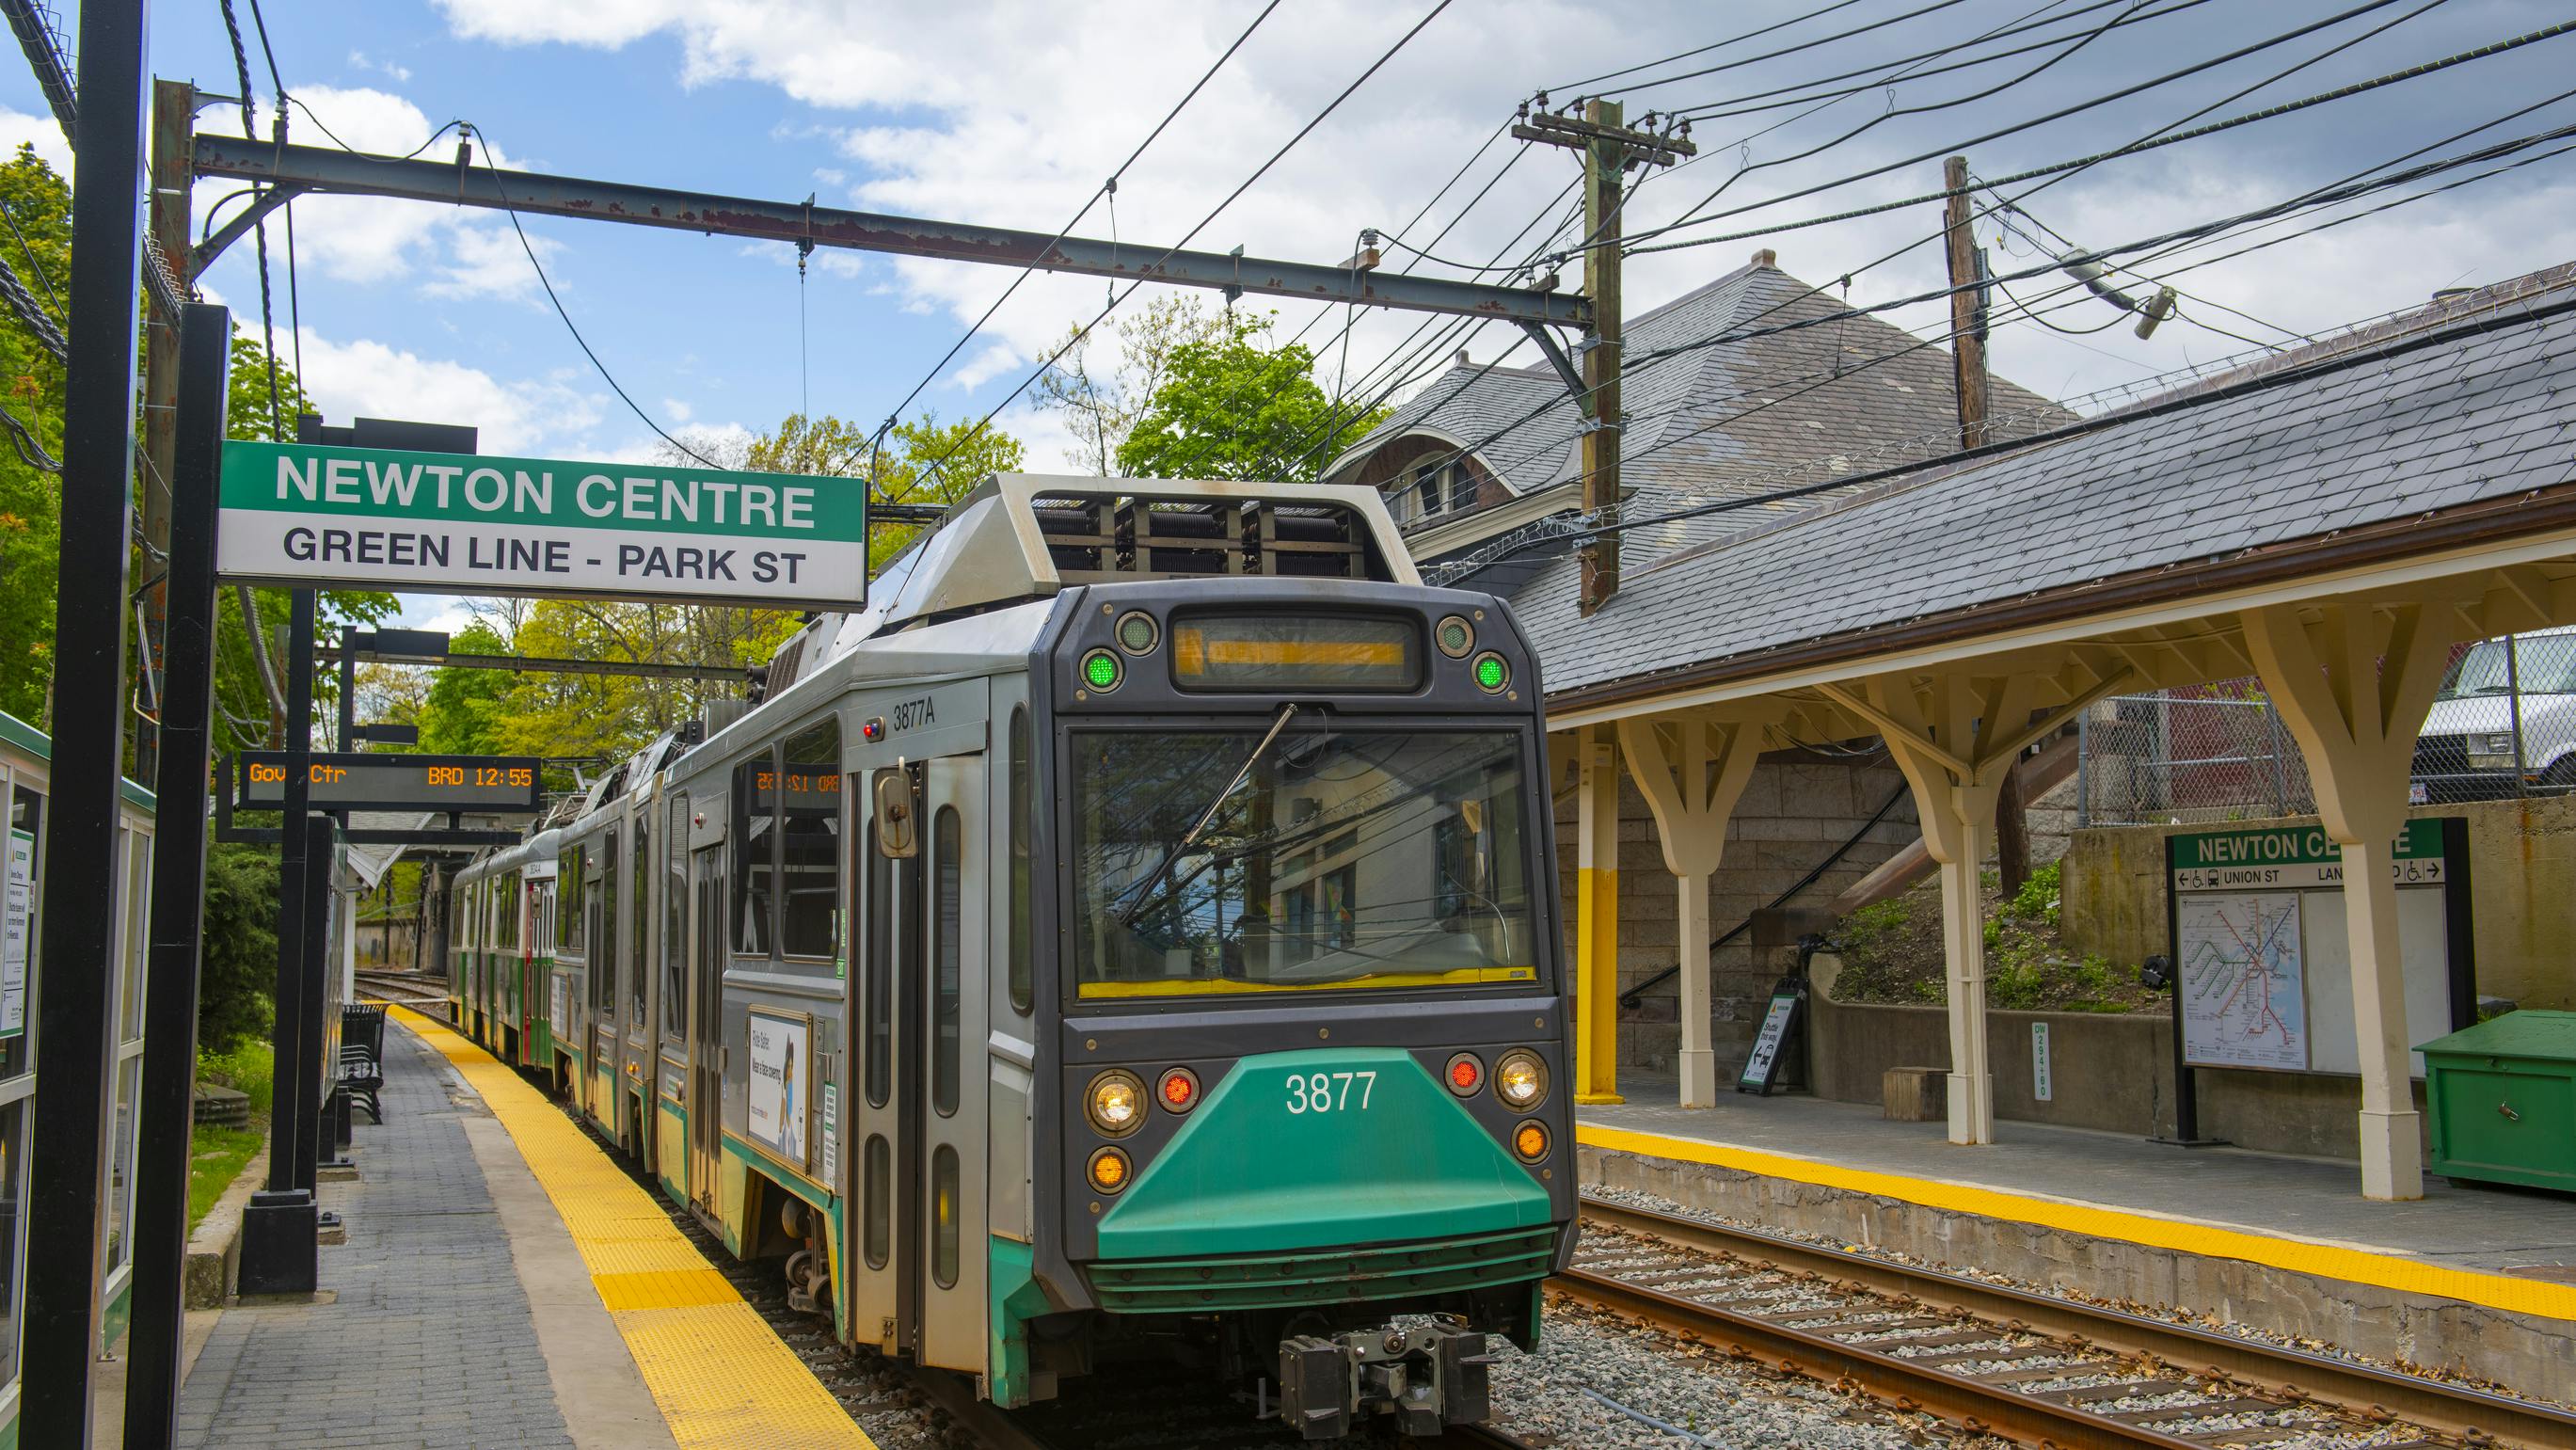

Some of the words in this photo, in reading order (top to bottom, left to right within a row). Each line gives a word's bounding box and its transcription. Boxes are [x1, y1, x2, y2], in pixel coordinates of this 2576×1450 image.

[277, 455, 553, 515] NEWTON
[576, 474, 815, 529] CENTRE
[283, 527, 450, 567] GREEN
[469, 536, 570, 573] LINE
[618, 544, 738, 582] PARK
[753, 550, 806, 584] ST
[894, 695, 935, 732] 3877A
[249, 763, 286, 783] Gov
[310, 764, 347, 784] Ctr
[428, 767, 464, 786] BRD
[475, 768, 533, 787] 12:55
[2198, 833, 2298, 862] NEWTON
[2307, 827, 2411, 857] CEE
[2224, 870, 2261, 884] UNION
[2265, 869, 2280, 883] ST
[1286, 1071, 1376, 1114] 3877
